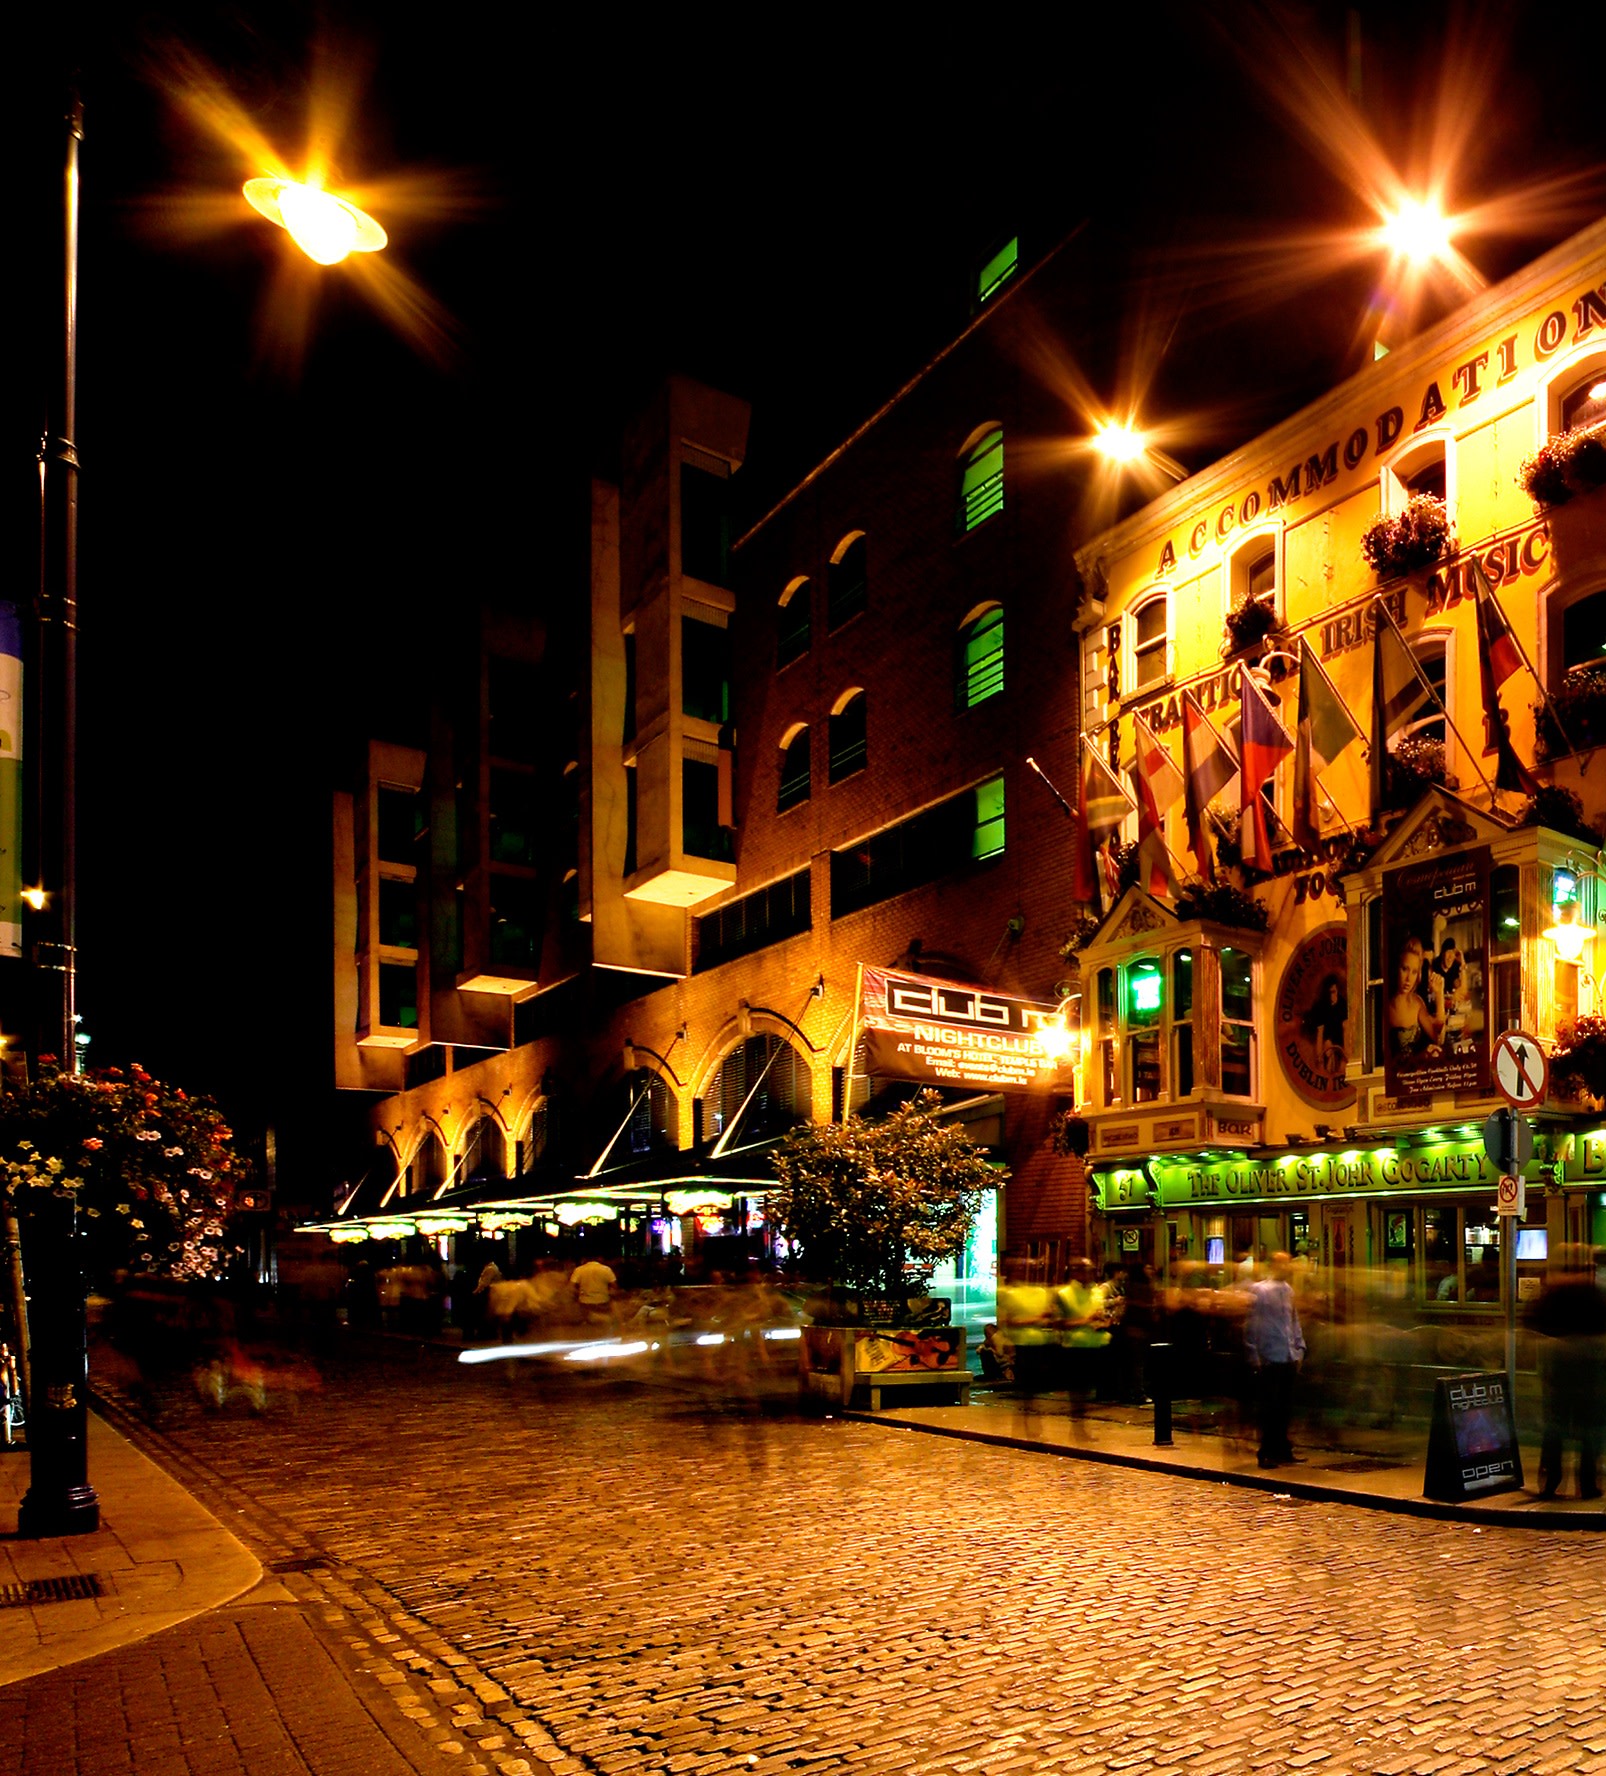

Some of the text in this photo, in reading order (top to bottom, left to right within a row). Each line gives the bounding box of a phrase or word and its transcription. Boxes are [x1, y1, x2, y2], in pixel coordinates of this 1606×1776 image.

[1424, 528, 1550, 621] MUSIC
[892, 986, 1010, 1026] club
[913, 1025, 1044, 1056] NIGHTCLUB
[935, 1067, 962, 1079] Web:
[1187, 1168, 1220, 1198] THE
[1225, 1163, 1289, 1195] OLIVER
[1326, 1157, 1374, 1191] JOHN
[1381, 1150, 1488, 1185] GOGARTY
[1450, 1382, 1503, 1401] club m
[1452, 1396, 1504, 1411] nightclub
[1462, 1460, 1514, 1479] open
